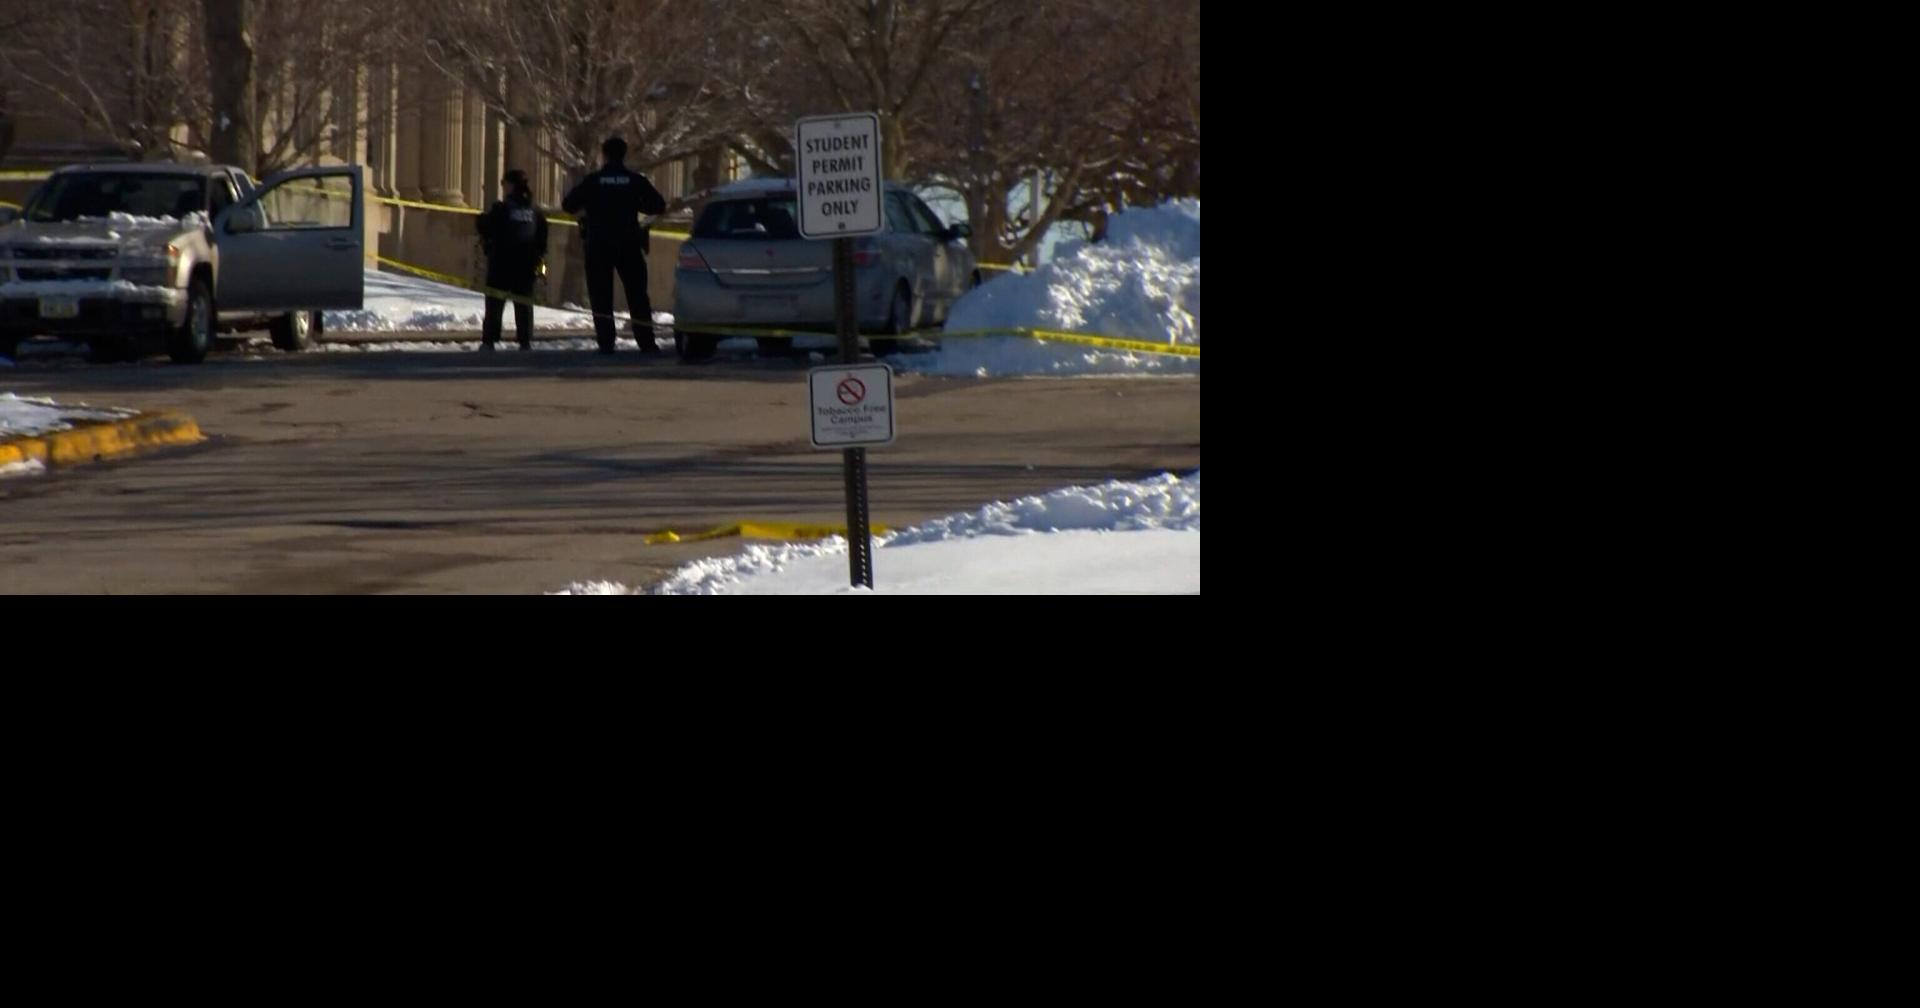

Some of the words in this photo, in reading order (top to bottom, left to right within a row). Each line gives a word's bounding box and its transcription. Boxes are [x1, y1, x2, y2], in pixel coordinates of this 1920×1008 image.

[806, 134, 868, 153] STUDENT
[813, 156, 863, 174] PERMIT
[808, 177, 871, 196] PARKING
[821, 200, 859, 216] ONLY
[817, 406, 861, 417] Tobacco
[863, 404, 886, 413] Free
[830, 415, 873, 425] Campus
